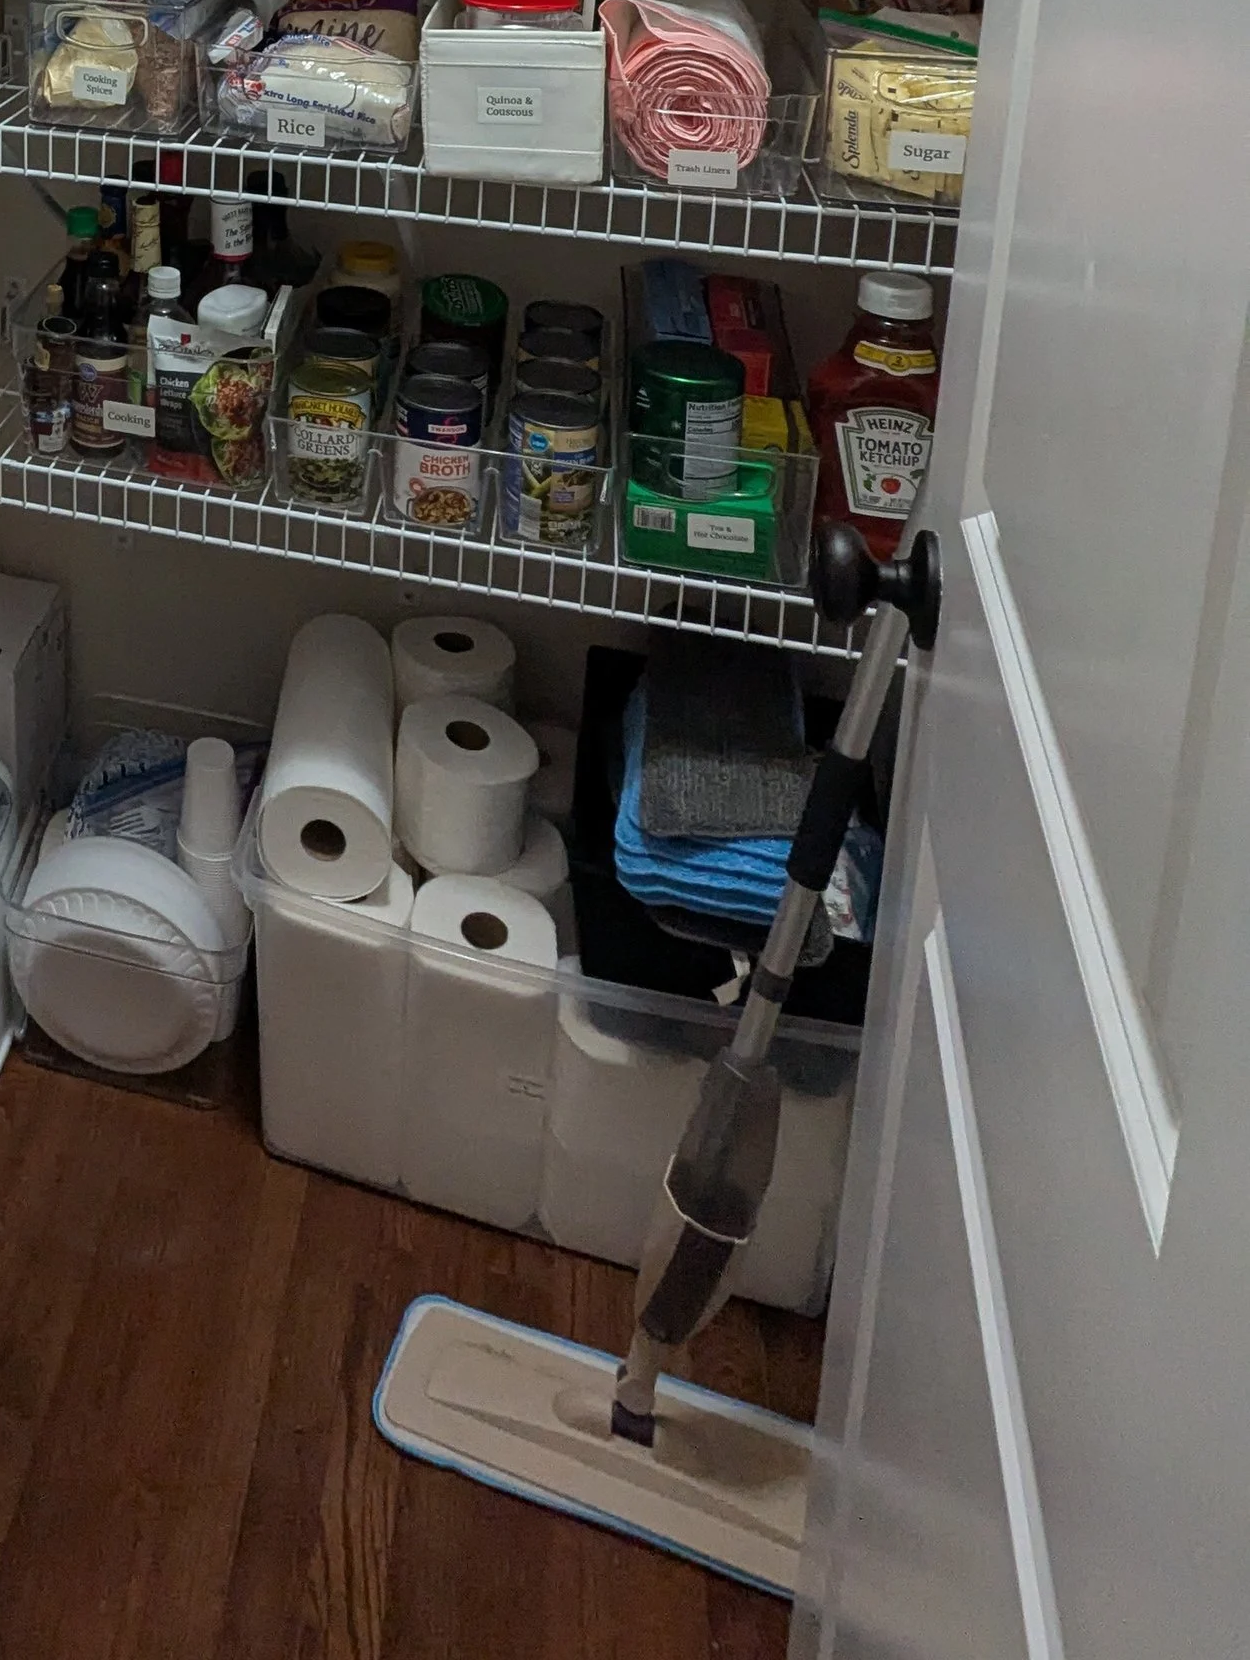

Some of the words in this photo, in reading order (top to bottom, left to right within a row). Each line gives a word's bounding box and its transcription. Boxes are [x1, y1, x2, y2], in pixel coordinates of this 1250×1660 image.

[82, 72, 118, 89] Cooking
[85, 83, 113, 98] Spices
[264, 88, 284, 103] xtra
[286, 92, 310, 110] Long
[313, 98, 355, 120] Enriched
[357, 111, 377, 125] Rice
[486, 94, 523, 108] Quinoa
[525, 95, 533, 105] &
[486, 106, 534, 118] Couscous
[277, 118, 315, 137] Rice
[841, 109, 861, 170] Splenda
[903, 144, 951, 161] Sugar
[674, 163, 700, 174] Trash
[702, 165, 731, 176] Liners
[225, 228, 238, 237] The
[233, 238, 244, 247] the
[160, 377, 189, 388] Chicken
[688, 403, 726, 411] Nutrition
[108, 411, 151, 429] Cooking
[866, 418, 914, 434] HEINZ
[294, 426, 355, 445] COLLARD
[298, 438, 350, 456] GREENS
[855, 436, 923, 455] TOMATO
[423, 454, 469, 466] CHICKEN
[859, 451, 920, 467] KETCHUP
[419, 461, 471, 477] BROTH
[709, 524, 724, 532] Tea
[693, 531, 708, 539] Hot
[710, 532, 749, 543] Chocolate
